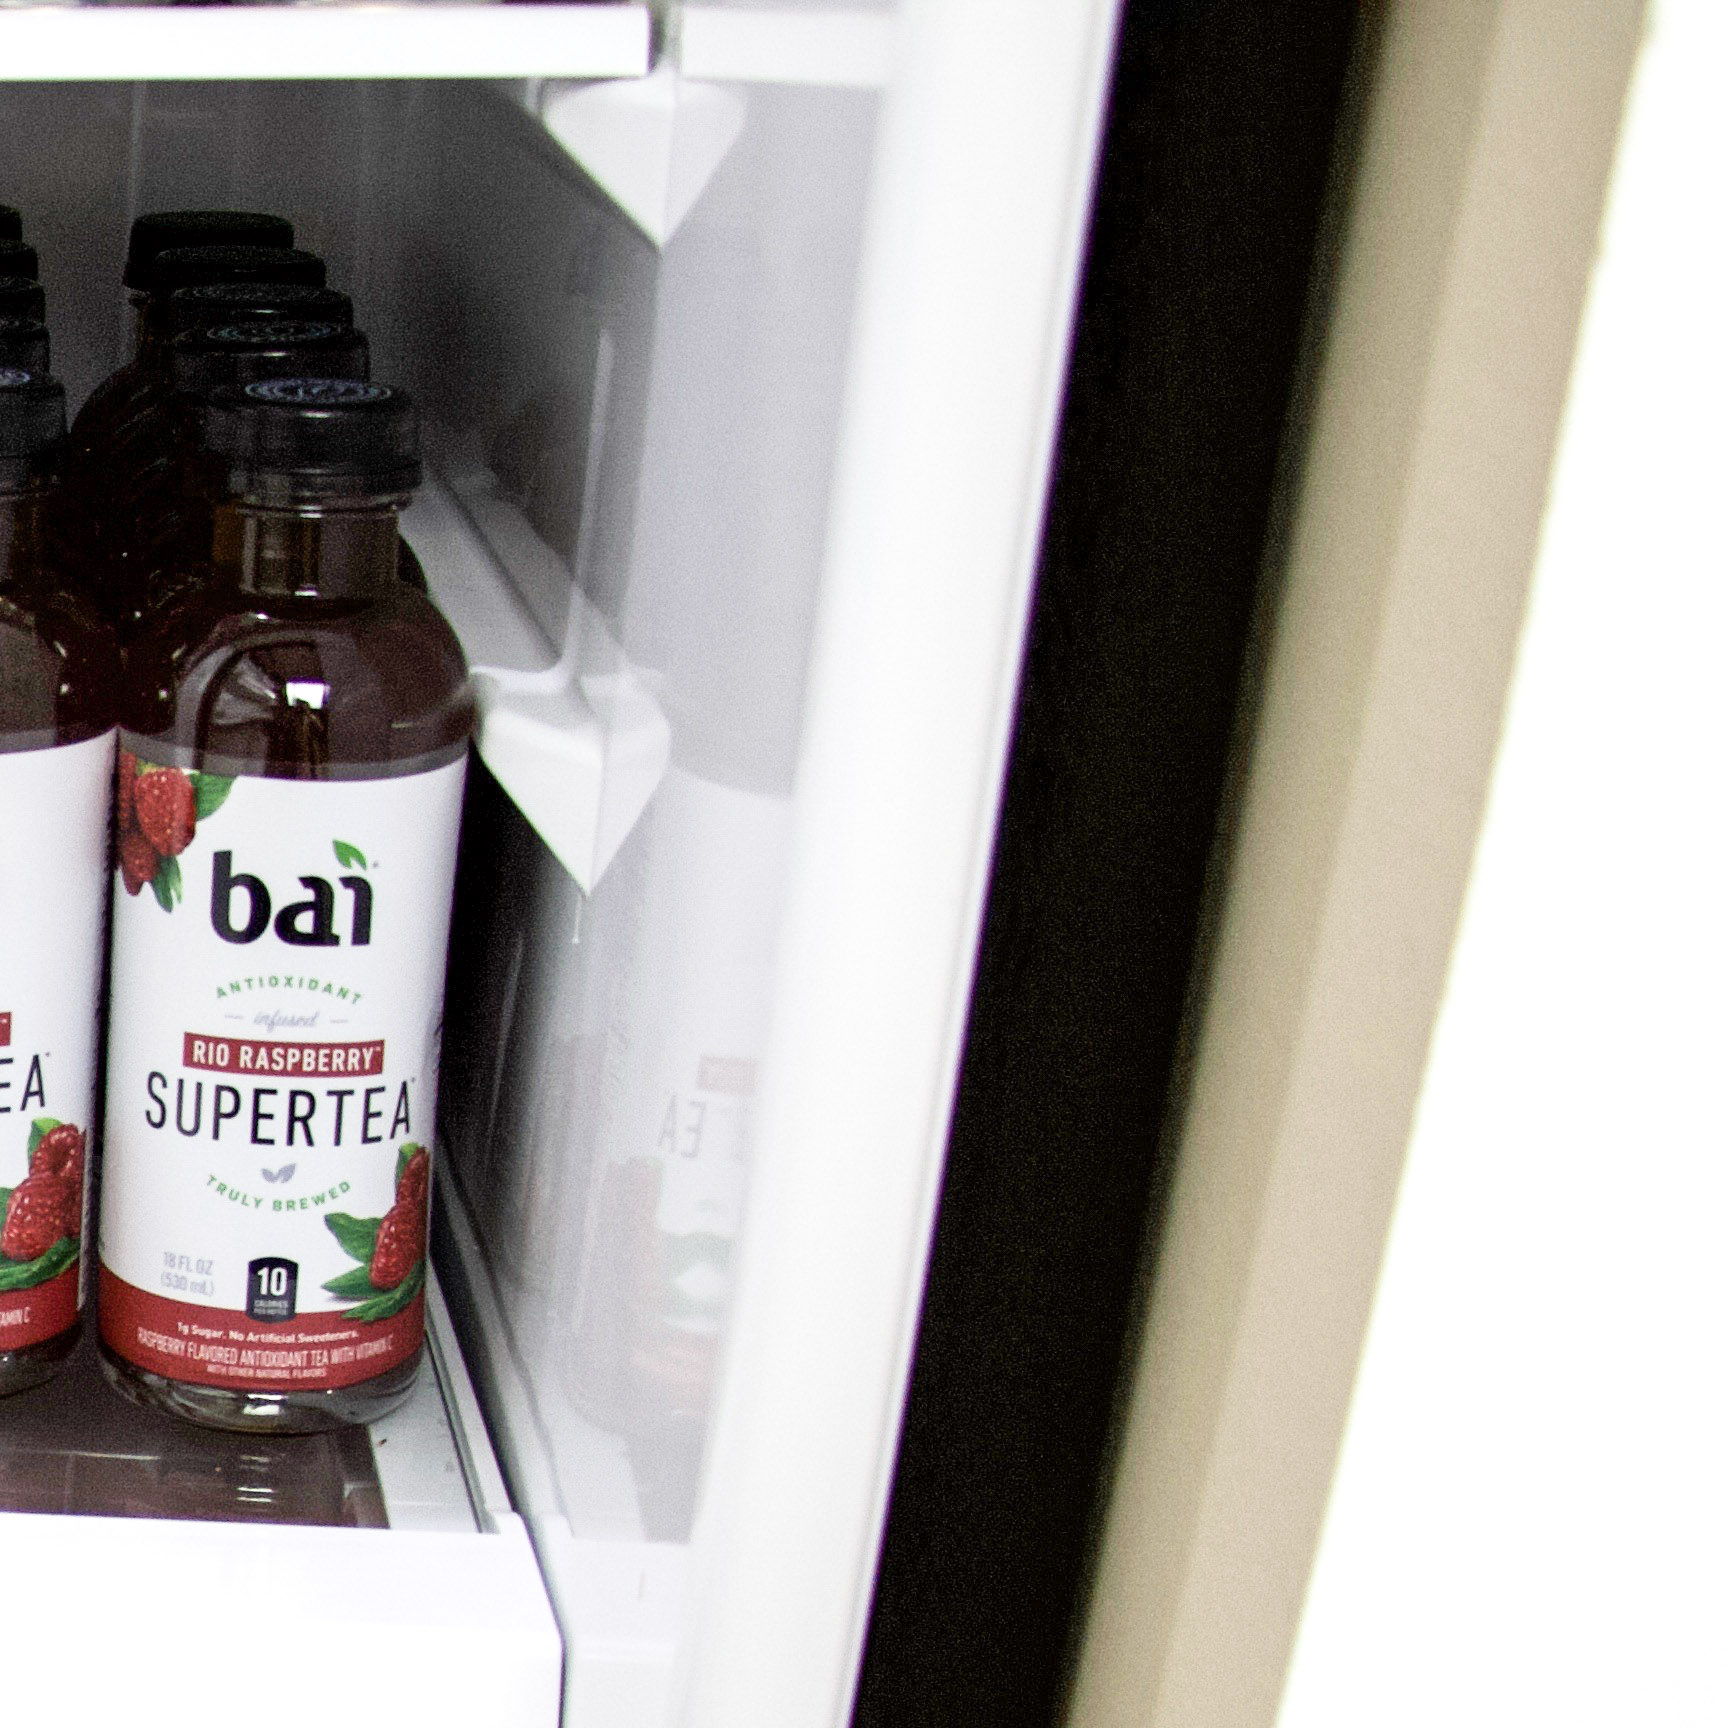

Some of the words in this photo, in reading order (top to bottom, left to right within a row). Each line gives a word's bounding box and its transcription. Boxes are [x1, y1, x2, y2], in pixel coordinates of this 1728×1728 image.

[211, 840, 373, 946] bai
[216, 975, 362, 1005] ANTIOXIDANT
[192, 1039, 230, 1067] RIO
[206, 1174, 263, 1209] TRULY
[272, 1180, 351, 1212] BREWED
[257, 1267, 288, 1296] 10
[228, 1329, 245, 1341] No
